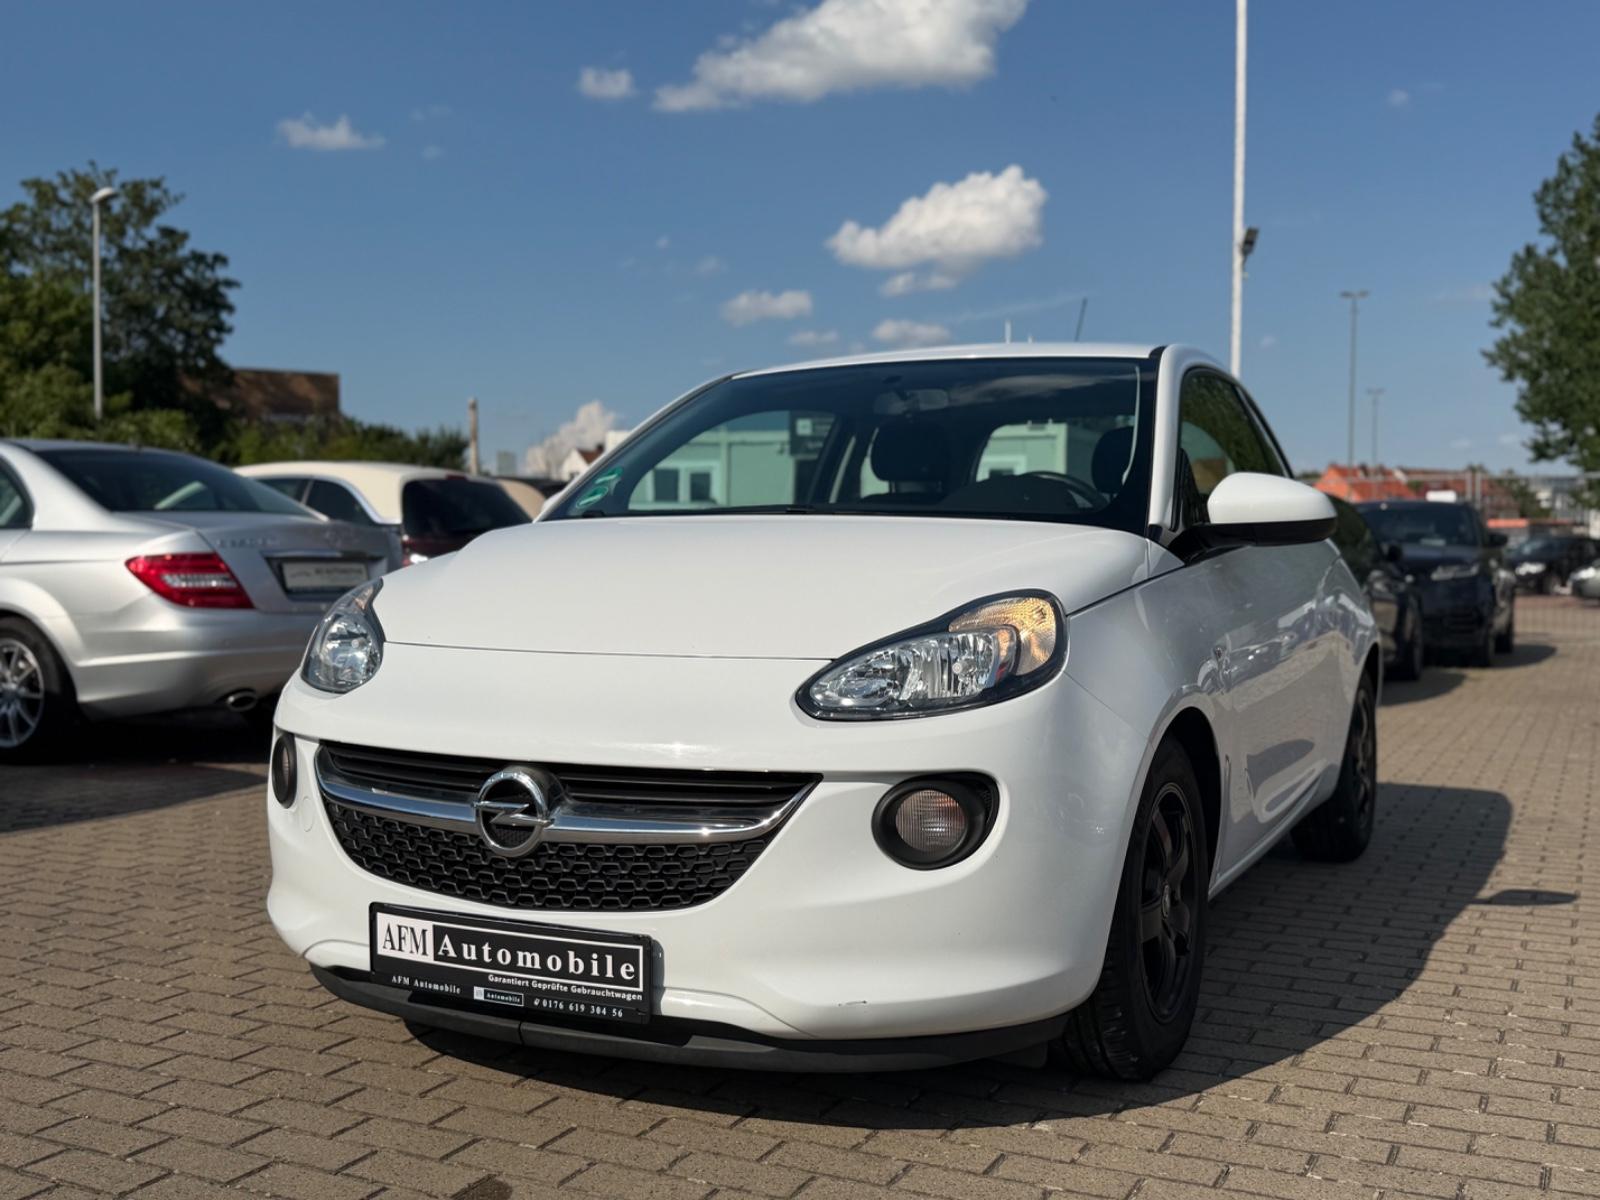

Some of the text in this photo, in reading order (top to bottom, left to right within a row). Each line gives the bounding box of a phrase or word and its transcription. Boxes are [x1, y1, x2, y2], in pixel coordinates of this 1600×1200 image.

[382, 922, 636, 981] AFM Automobile
[391, 975, 410, 986] AFM
[413, 978, 461, 994] Automobile
[488, 974, 529, 988] Garantiert
[531, 980, 569, 993] Geprüfte
[570, 985, 643, 1001] Gebrauchtwagen
[542, 998, 564, 1010] 0176
[569, 1002, 585, 1013] 619
[612, 1007, 623, 1018] 56
